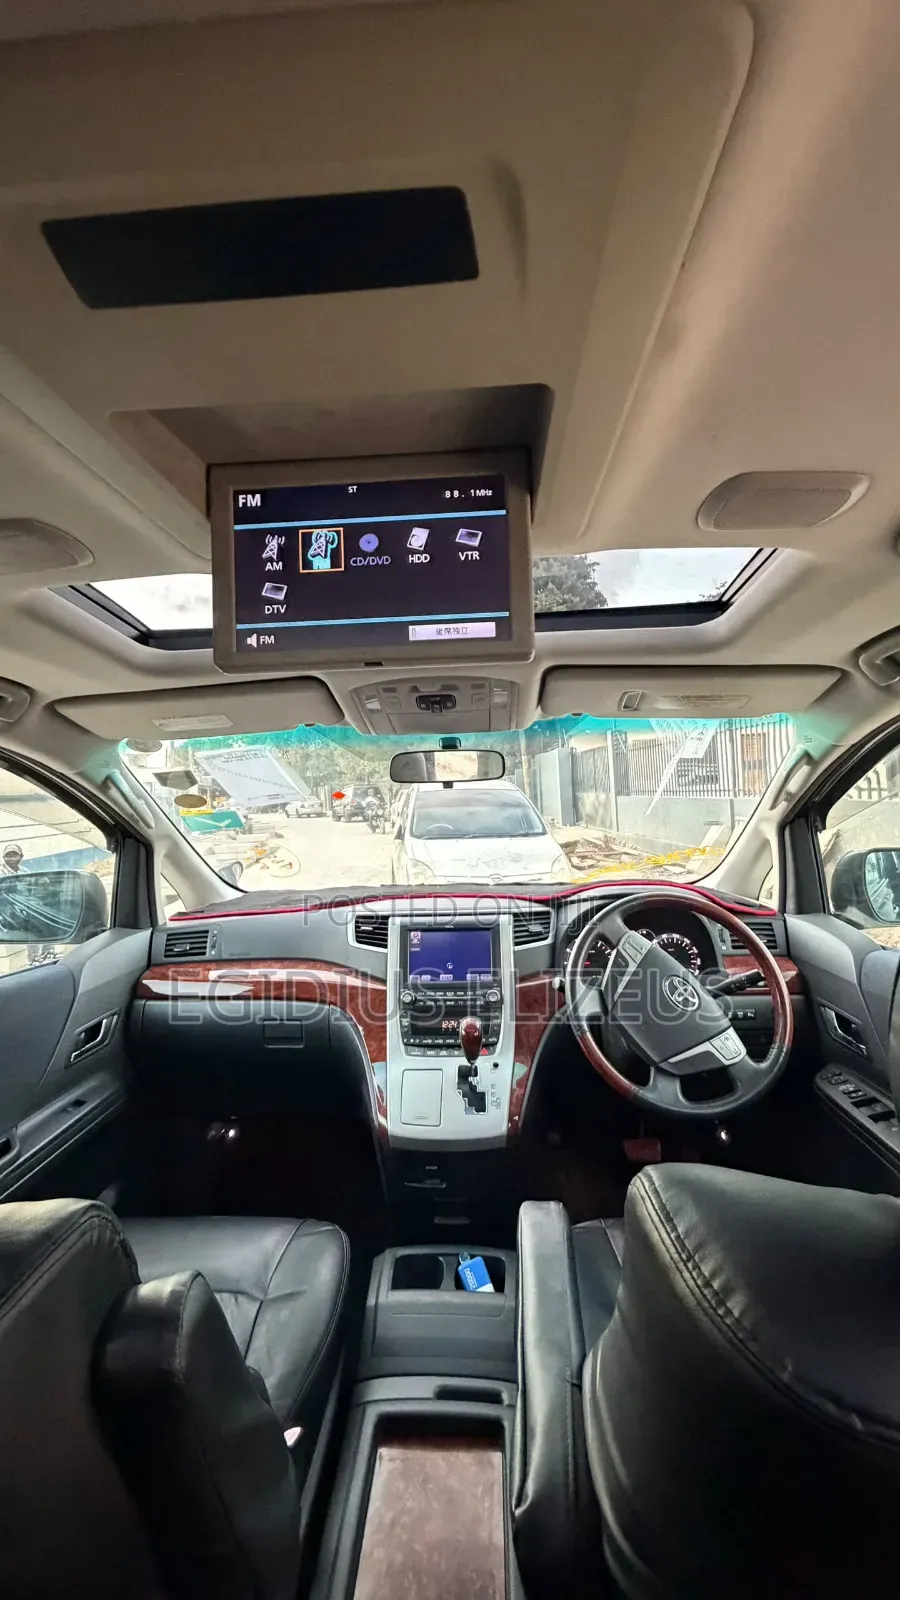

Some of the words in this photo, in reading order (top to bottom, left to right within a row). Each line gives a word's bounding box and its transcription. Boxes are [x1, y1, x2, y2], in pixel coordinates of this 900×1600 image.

[348, 485, 358, 493] ST
[238, 493, 261, 508] FM
[350, 555, 391, 566] CD/DVD
[408, 553, 430, 564] HDD
[458, 550, 480, 561] VTR
[264, 561, 283, 571] AM
[264, 604, 287, 615] DTV
[259, 635, 275, 645] FM
